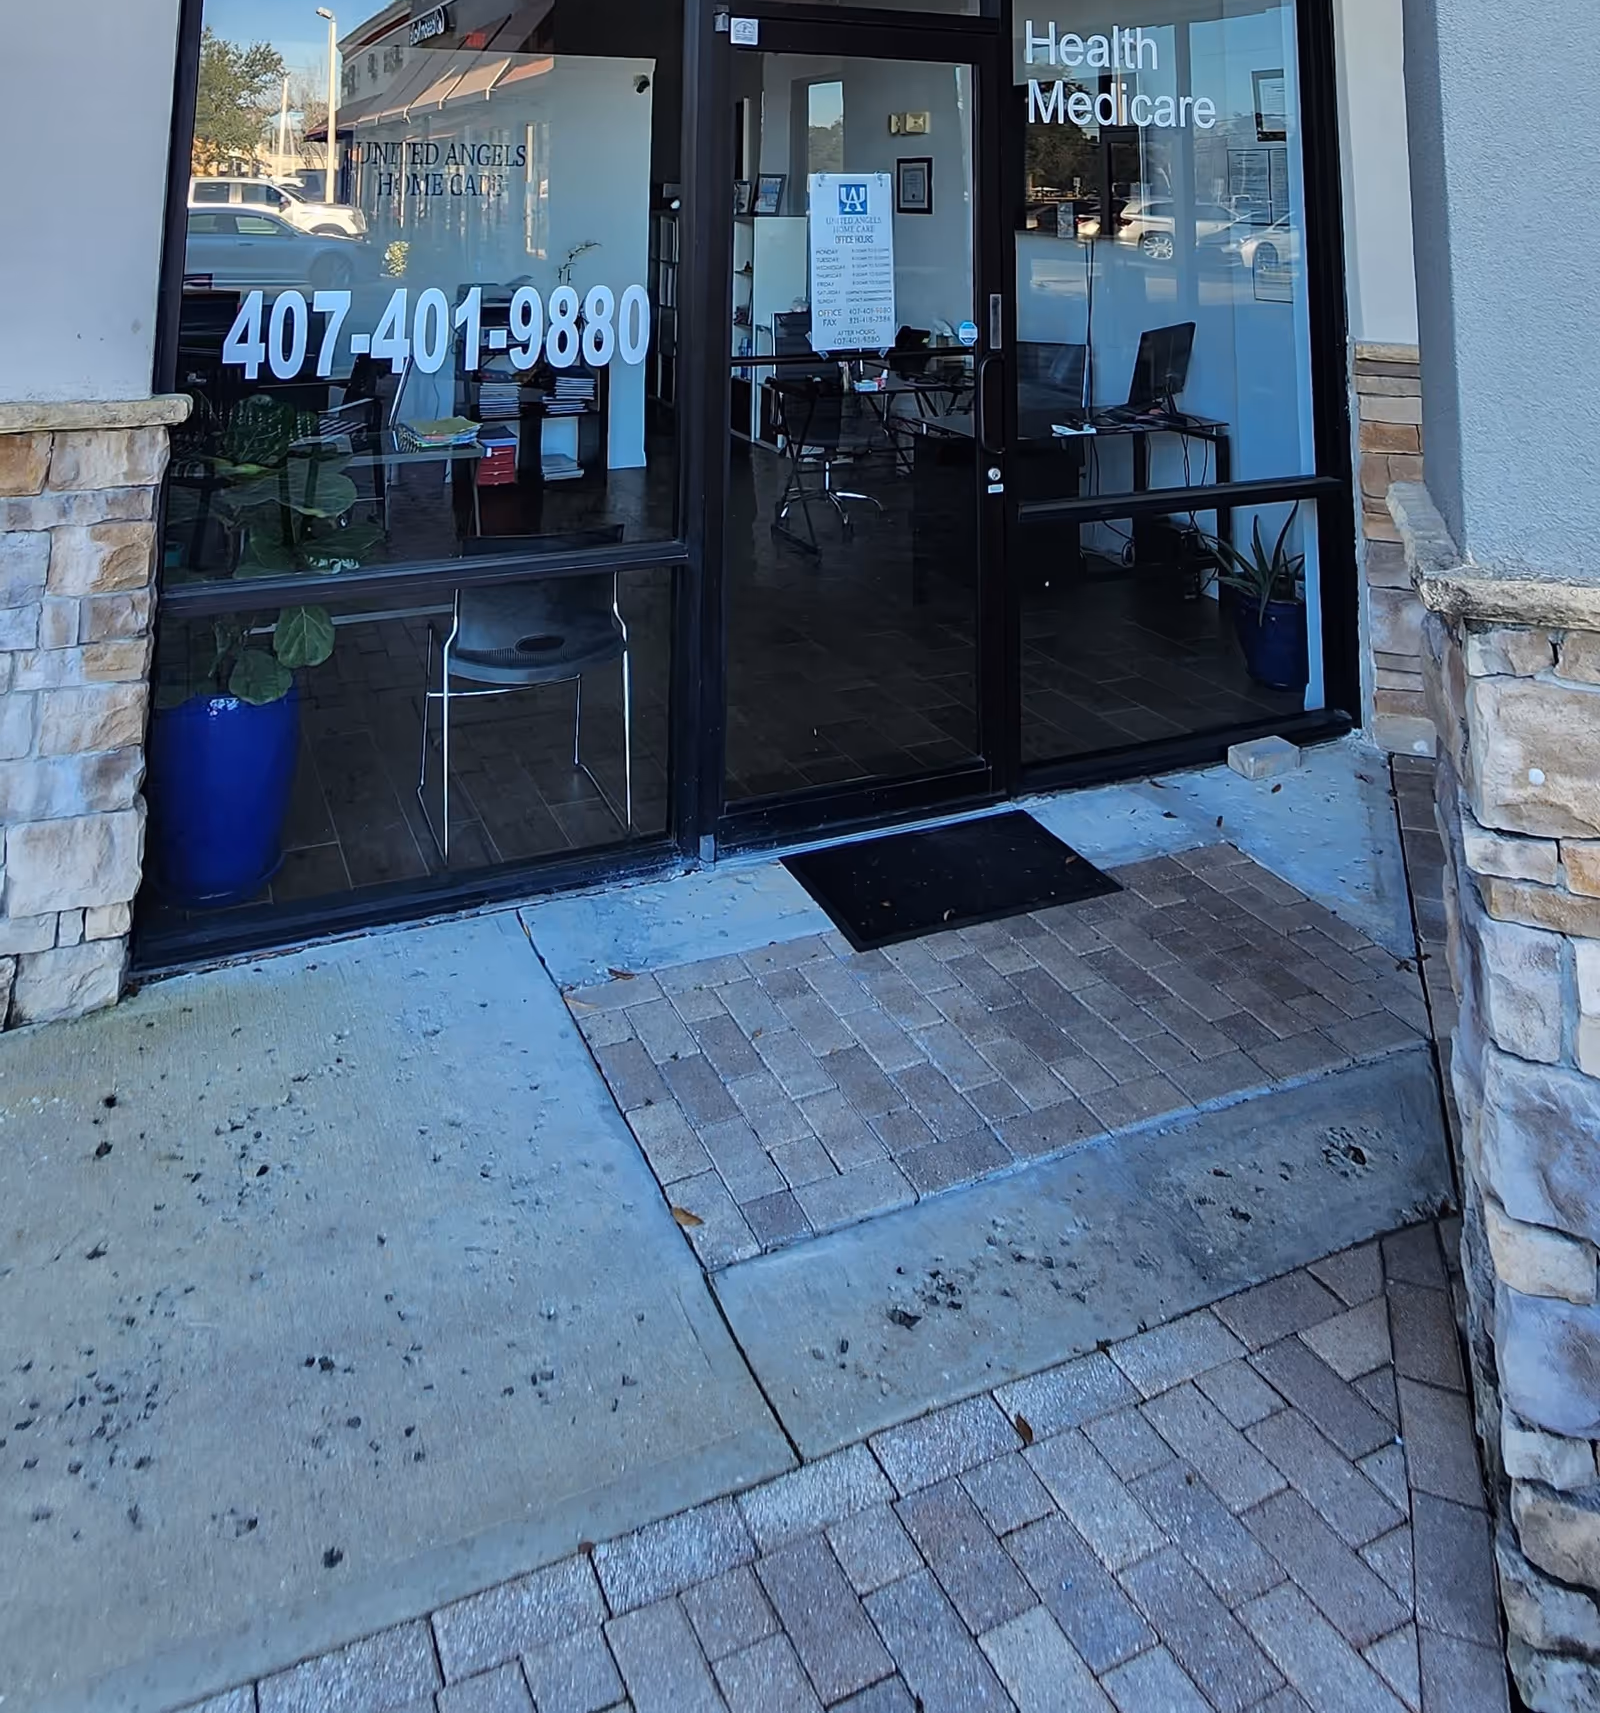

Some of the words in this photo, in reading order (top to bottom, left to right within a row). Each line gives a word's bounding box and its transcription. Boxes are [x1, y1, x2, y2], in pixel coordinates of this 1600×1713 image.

[1025, 20, 1158, 70] Health
[1027, 79, 1216, 129] Medicare
[356, 141, 440, 166] UNITED
[445, 142, 527, 167] ANGELS
[377, 173, 443, 197] HOME
[835, 235, 854, 244] OFFICE
[855, 234, 874, 244] HOURS
[817, 309, 842, 317] OFFICE
[823, 318, 837, 327] FAX
[221, 284, 651, 380] 407-401-9880
[855, 328, 876, 336] HOURS
